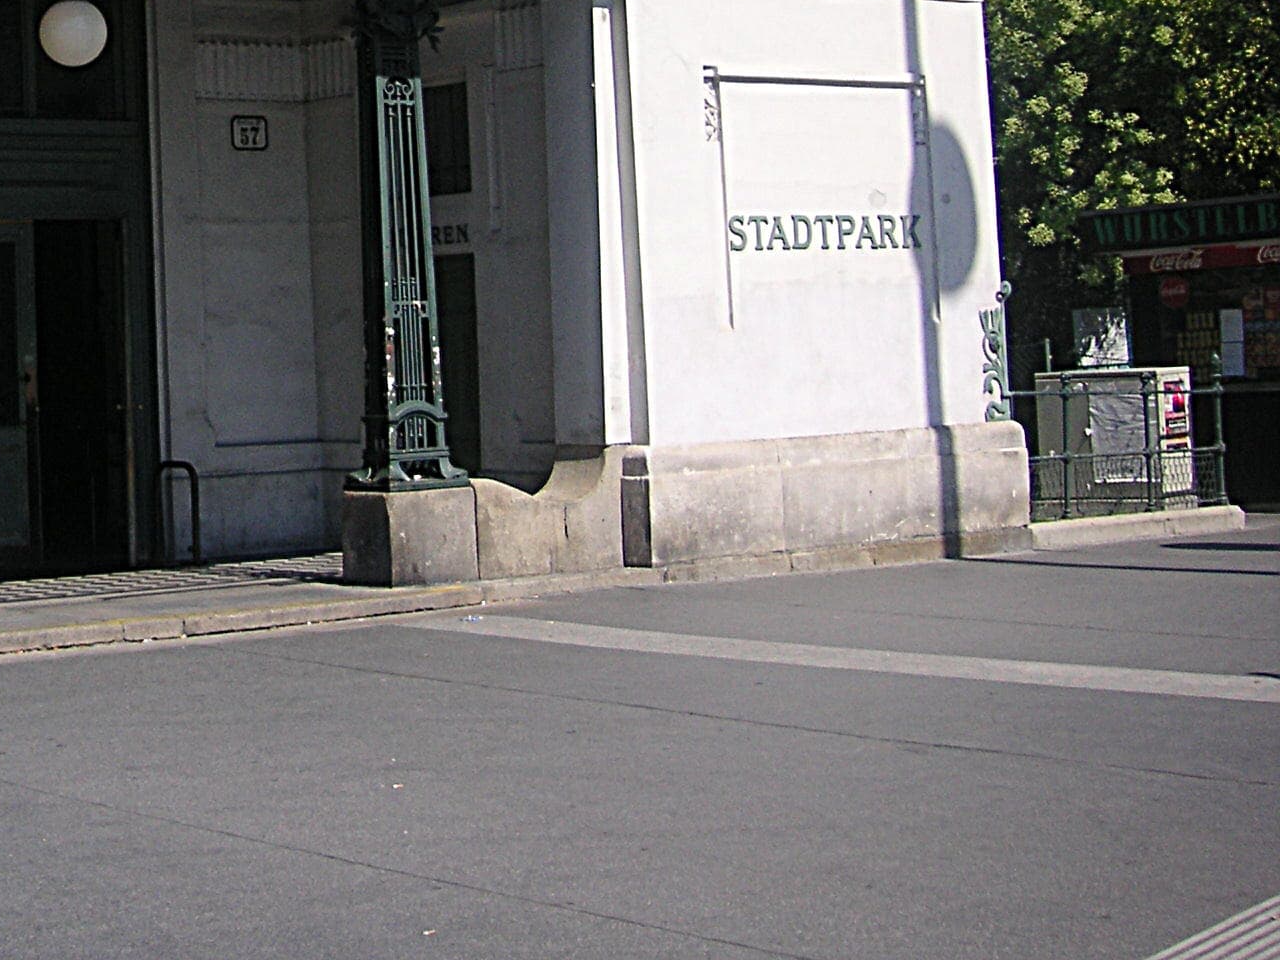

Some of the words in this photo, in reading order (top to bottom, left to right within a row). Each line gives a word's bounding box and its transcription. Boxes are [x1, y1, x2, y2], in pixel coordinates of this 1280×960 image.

[239, 126, 259, 145] 57
[728, 214, 921, 252] STADTPARK
[1149, 248, 1205, 272] Coca-Cola
